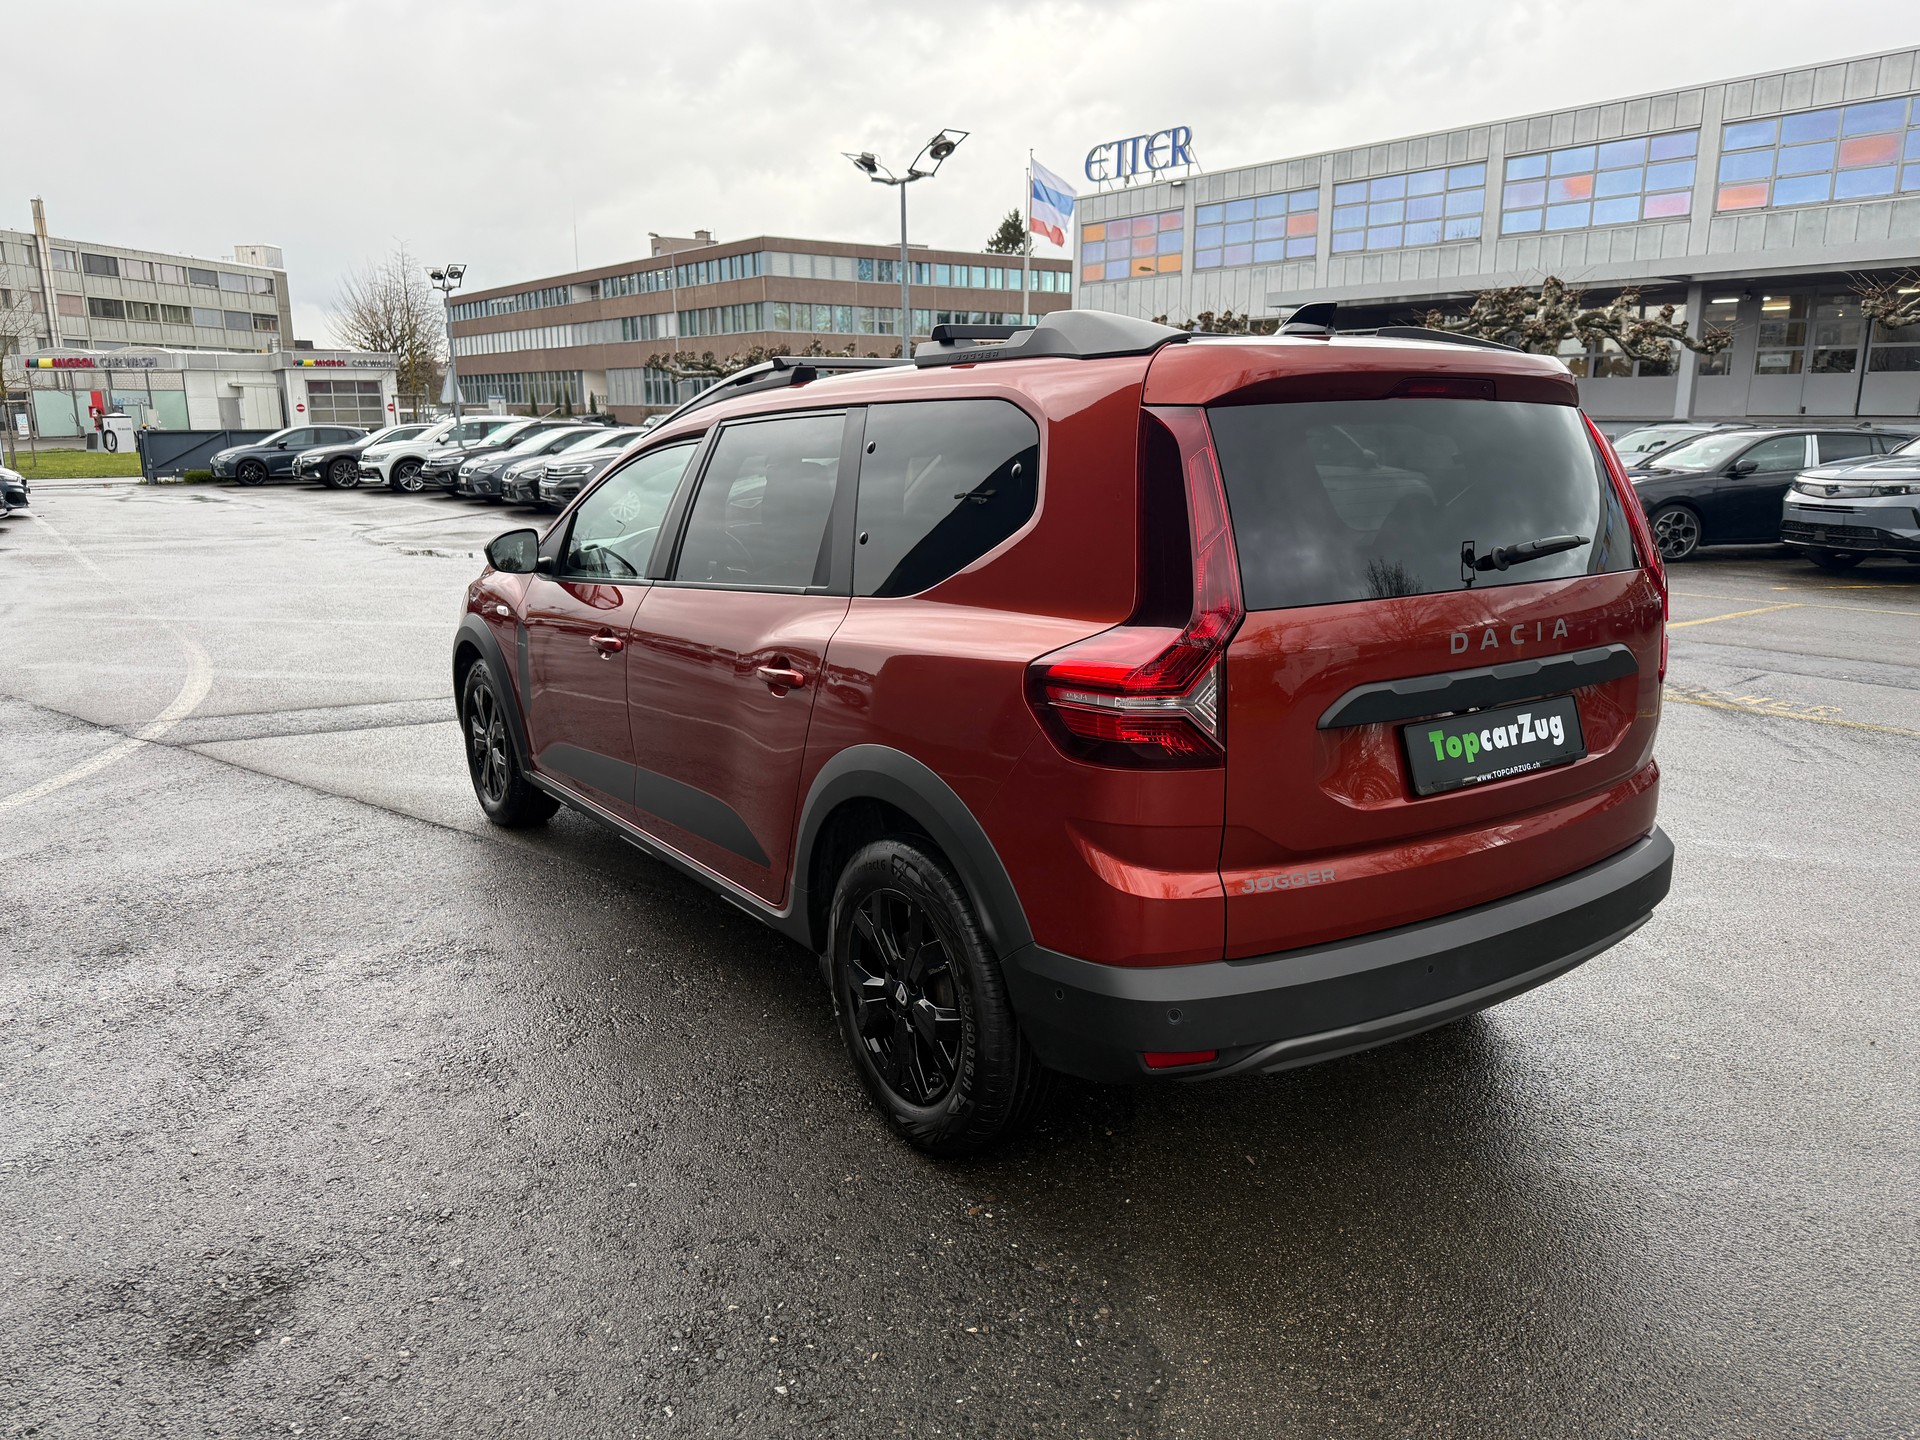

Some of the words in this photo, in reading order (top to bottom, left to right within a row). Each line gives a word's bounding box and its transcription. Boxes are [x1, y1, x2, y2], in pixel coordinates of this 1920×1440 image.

[1085, 125, 1195, 182] ETTER
[52, 357, 96, 368] MIGROL
[314, 359, 347, 367] MIGROL
[352, 359, 368, 368] CAR
[957, 351, 1000, 361] JOGGER
[1450, 618, 1569, 655] DACIA
[1428, 712, 1565, 763] TopcarZug
[1476, 761, 1541, 782] www.TOPCARZUG.ch
[1241, 869, 1336, 894] JOGGER
[960, 984, 976, 1045] 205/60
[965, 1046, 976, 1058] R
[962, 1076, 973, 1092] H
